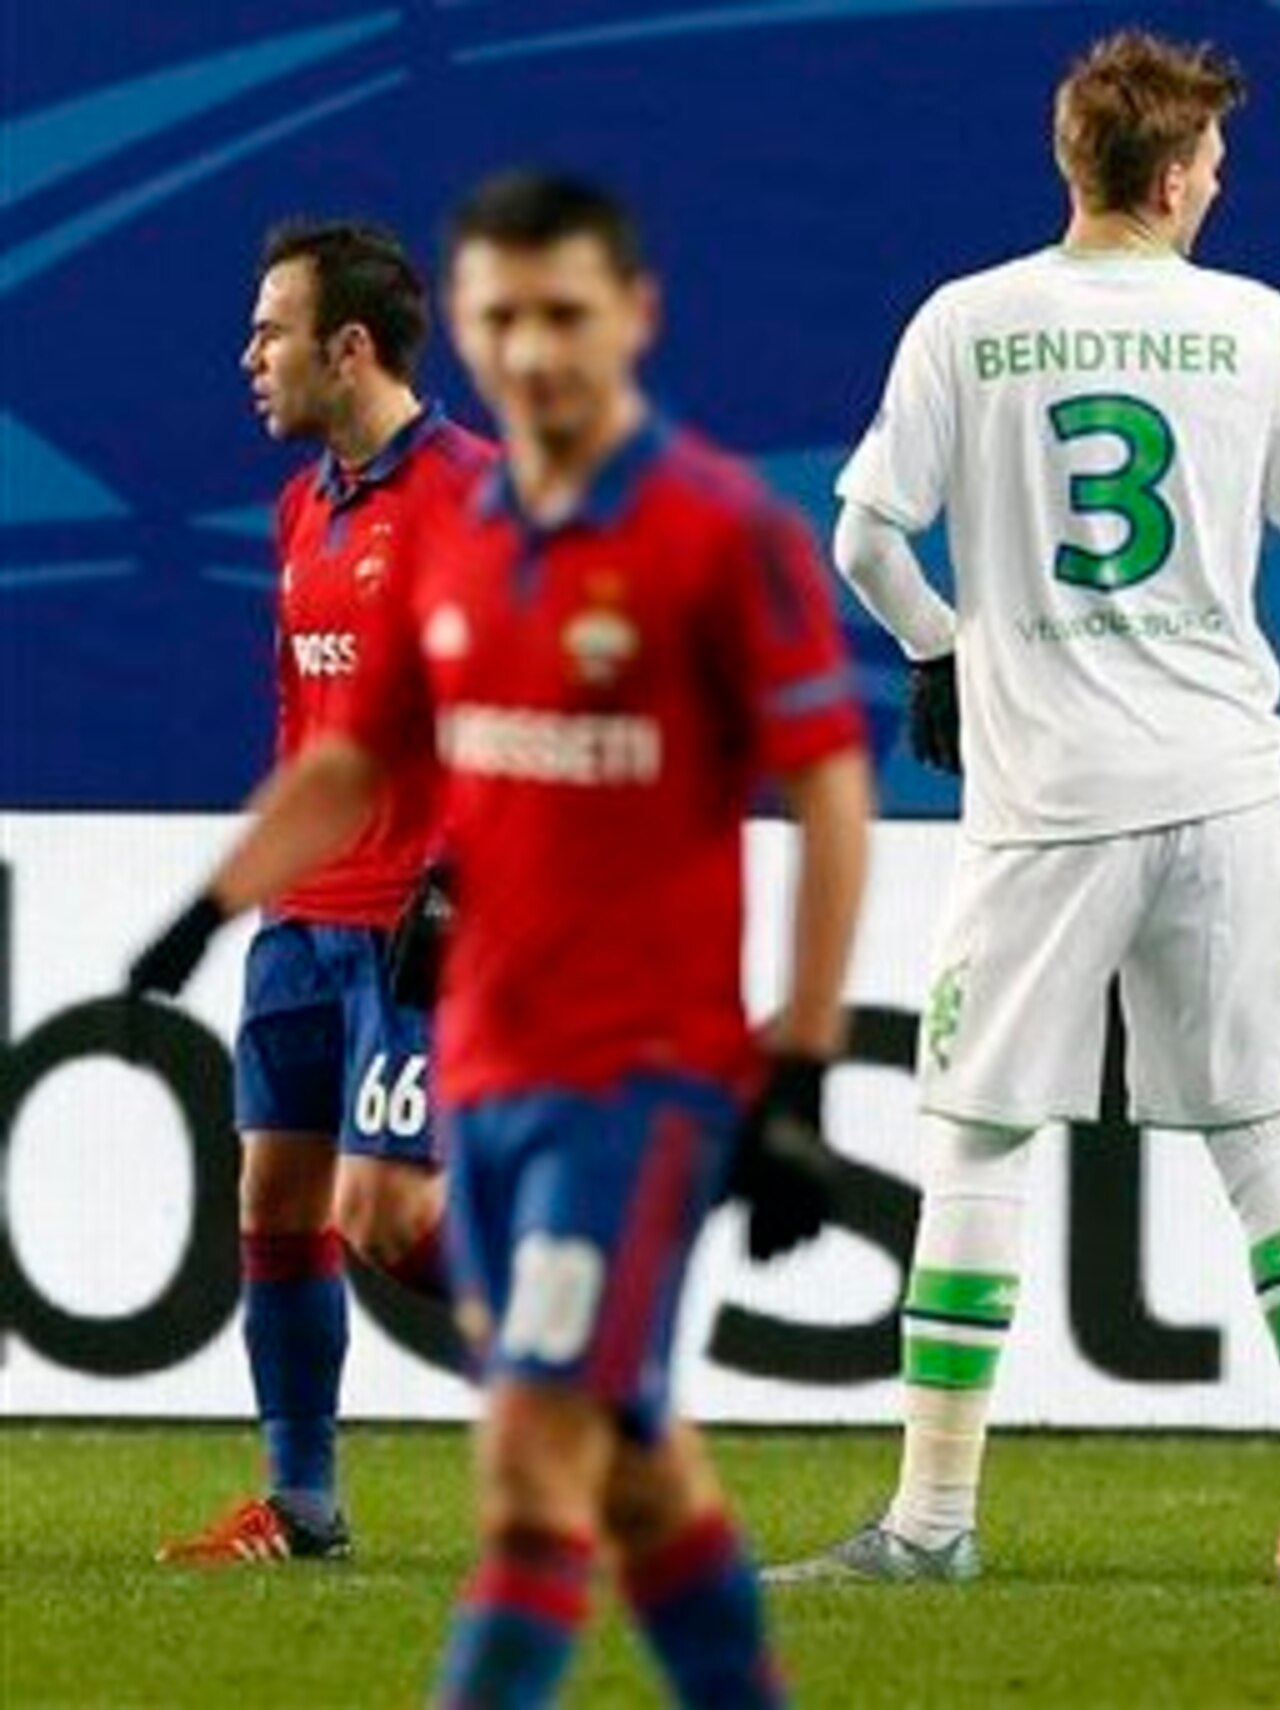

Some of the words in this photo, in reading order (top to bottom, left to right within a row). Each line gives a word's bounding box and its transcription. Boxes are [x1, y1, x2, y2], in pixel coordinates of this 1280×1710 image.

[974, 331, 1238, 381] BENDTNER
[1047, 392, 1177, 592] 3
[354, 1053, 428, 1137] 66
